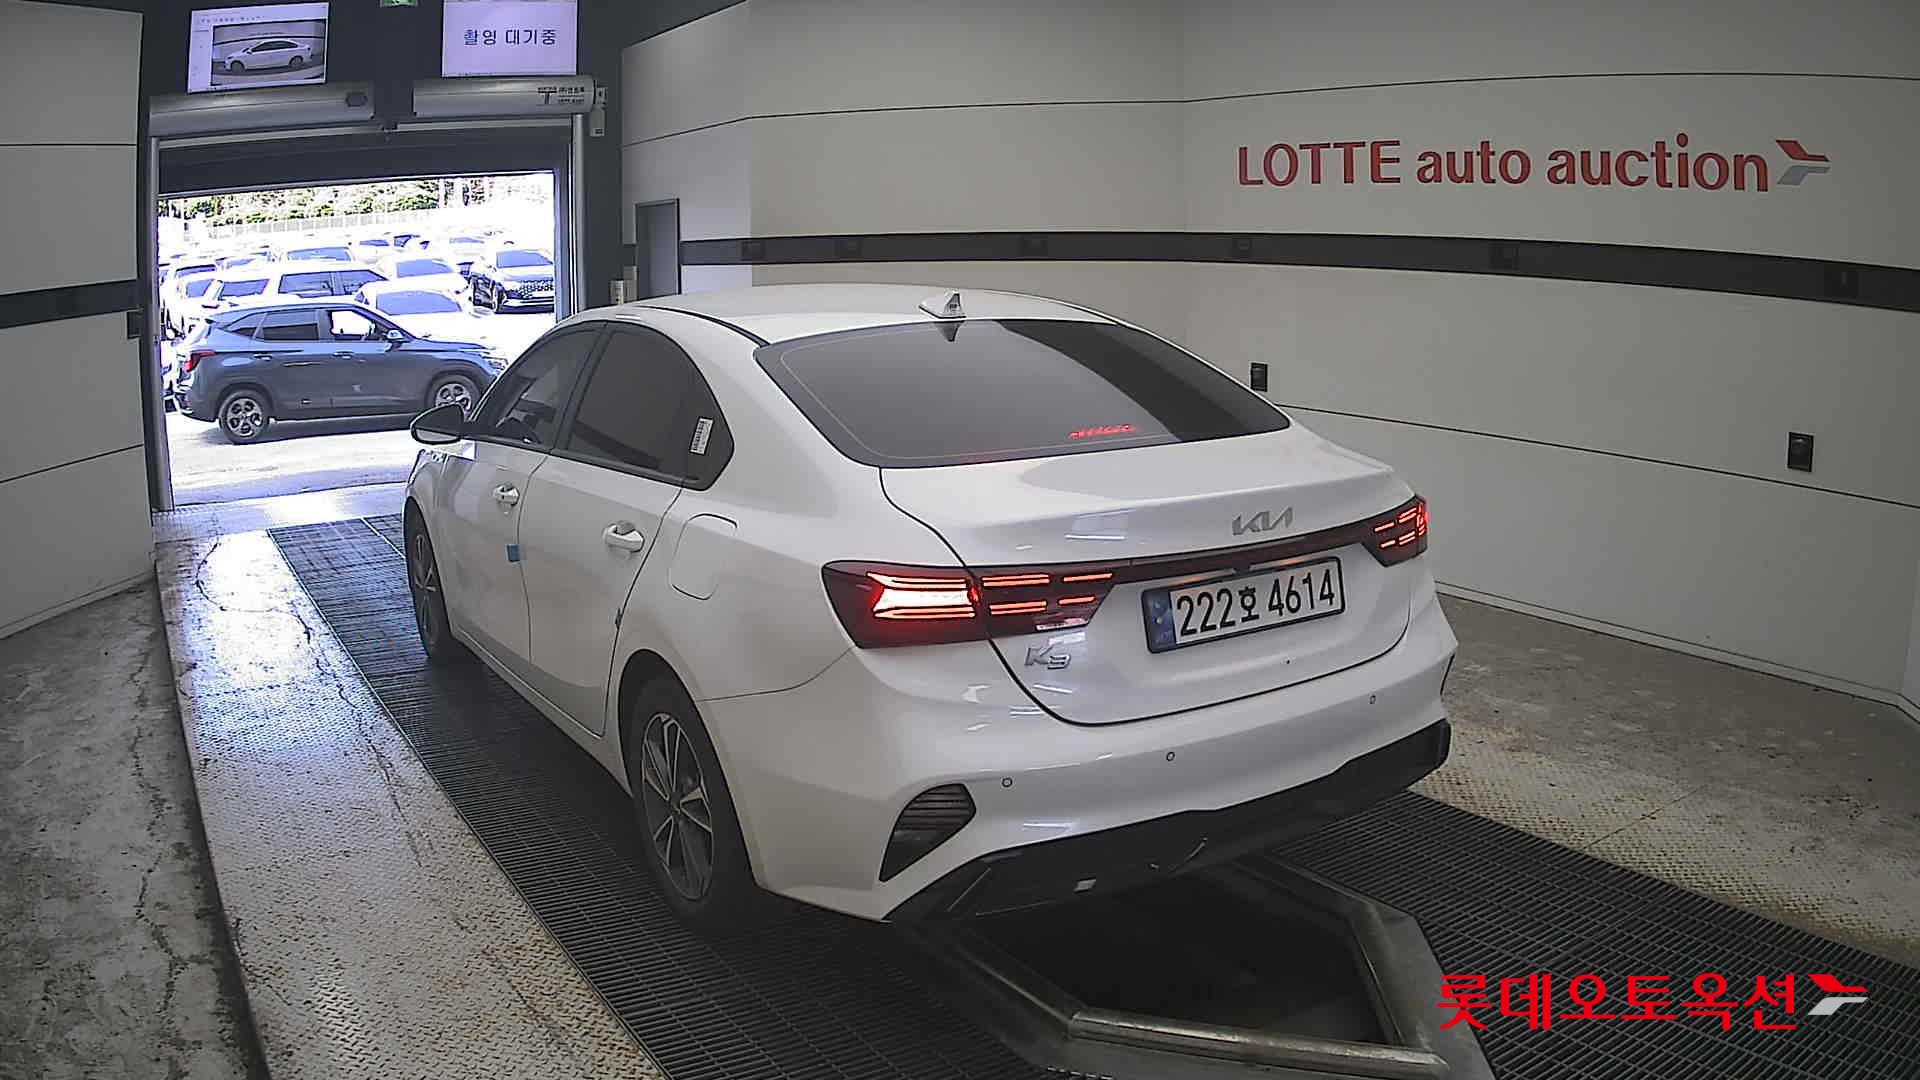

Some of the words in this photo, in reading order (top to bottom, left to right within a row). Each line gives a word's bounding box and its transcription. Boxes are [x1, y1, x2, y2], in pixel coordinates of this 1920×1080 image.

[464, 29, 497, 46] 촬영
[505, 29, 557, 46] 대기중
[1238, 140, 1401, 187] LOTTE
[1416, 141, 1532, 185] auto
[1546, 132, 1768, 192] auction
[1231, 506, 1293, 535] KIA
[1176, 586, 1260, 636] 222호
[1267, 568, 1335, 617] 4614
[1024, 643, 1072, 669] K3
